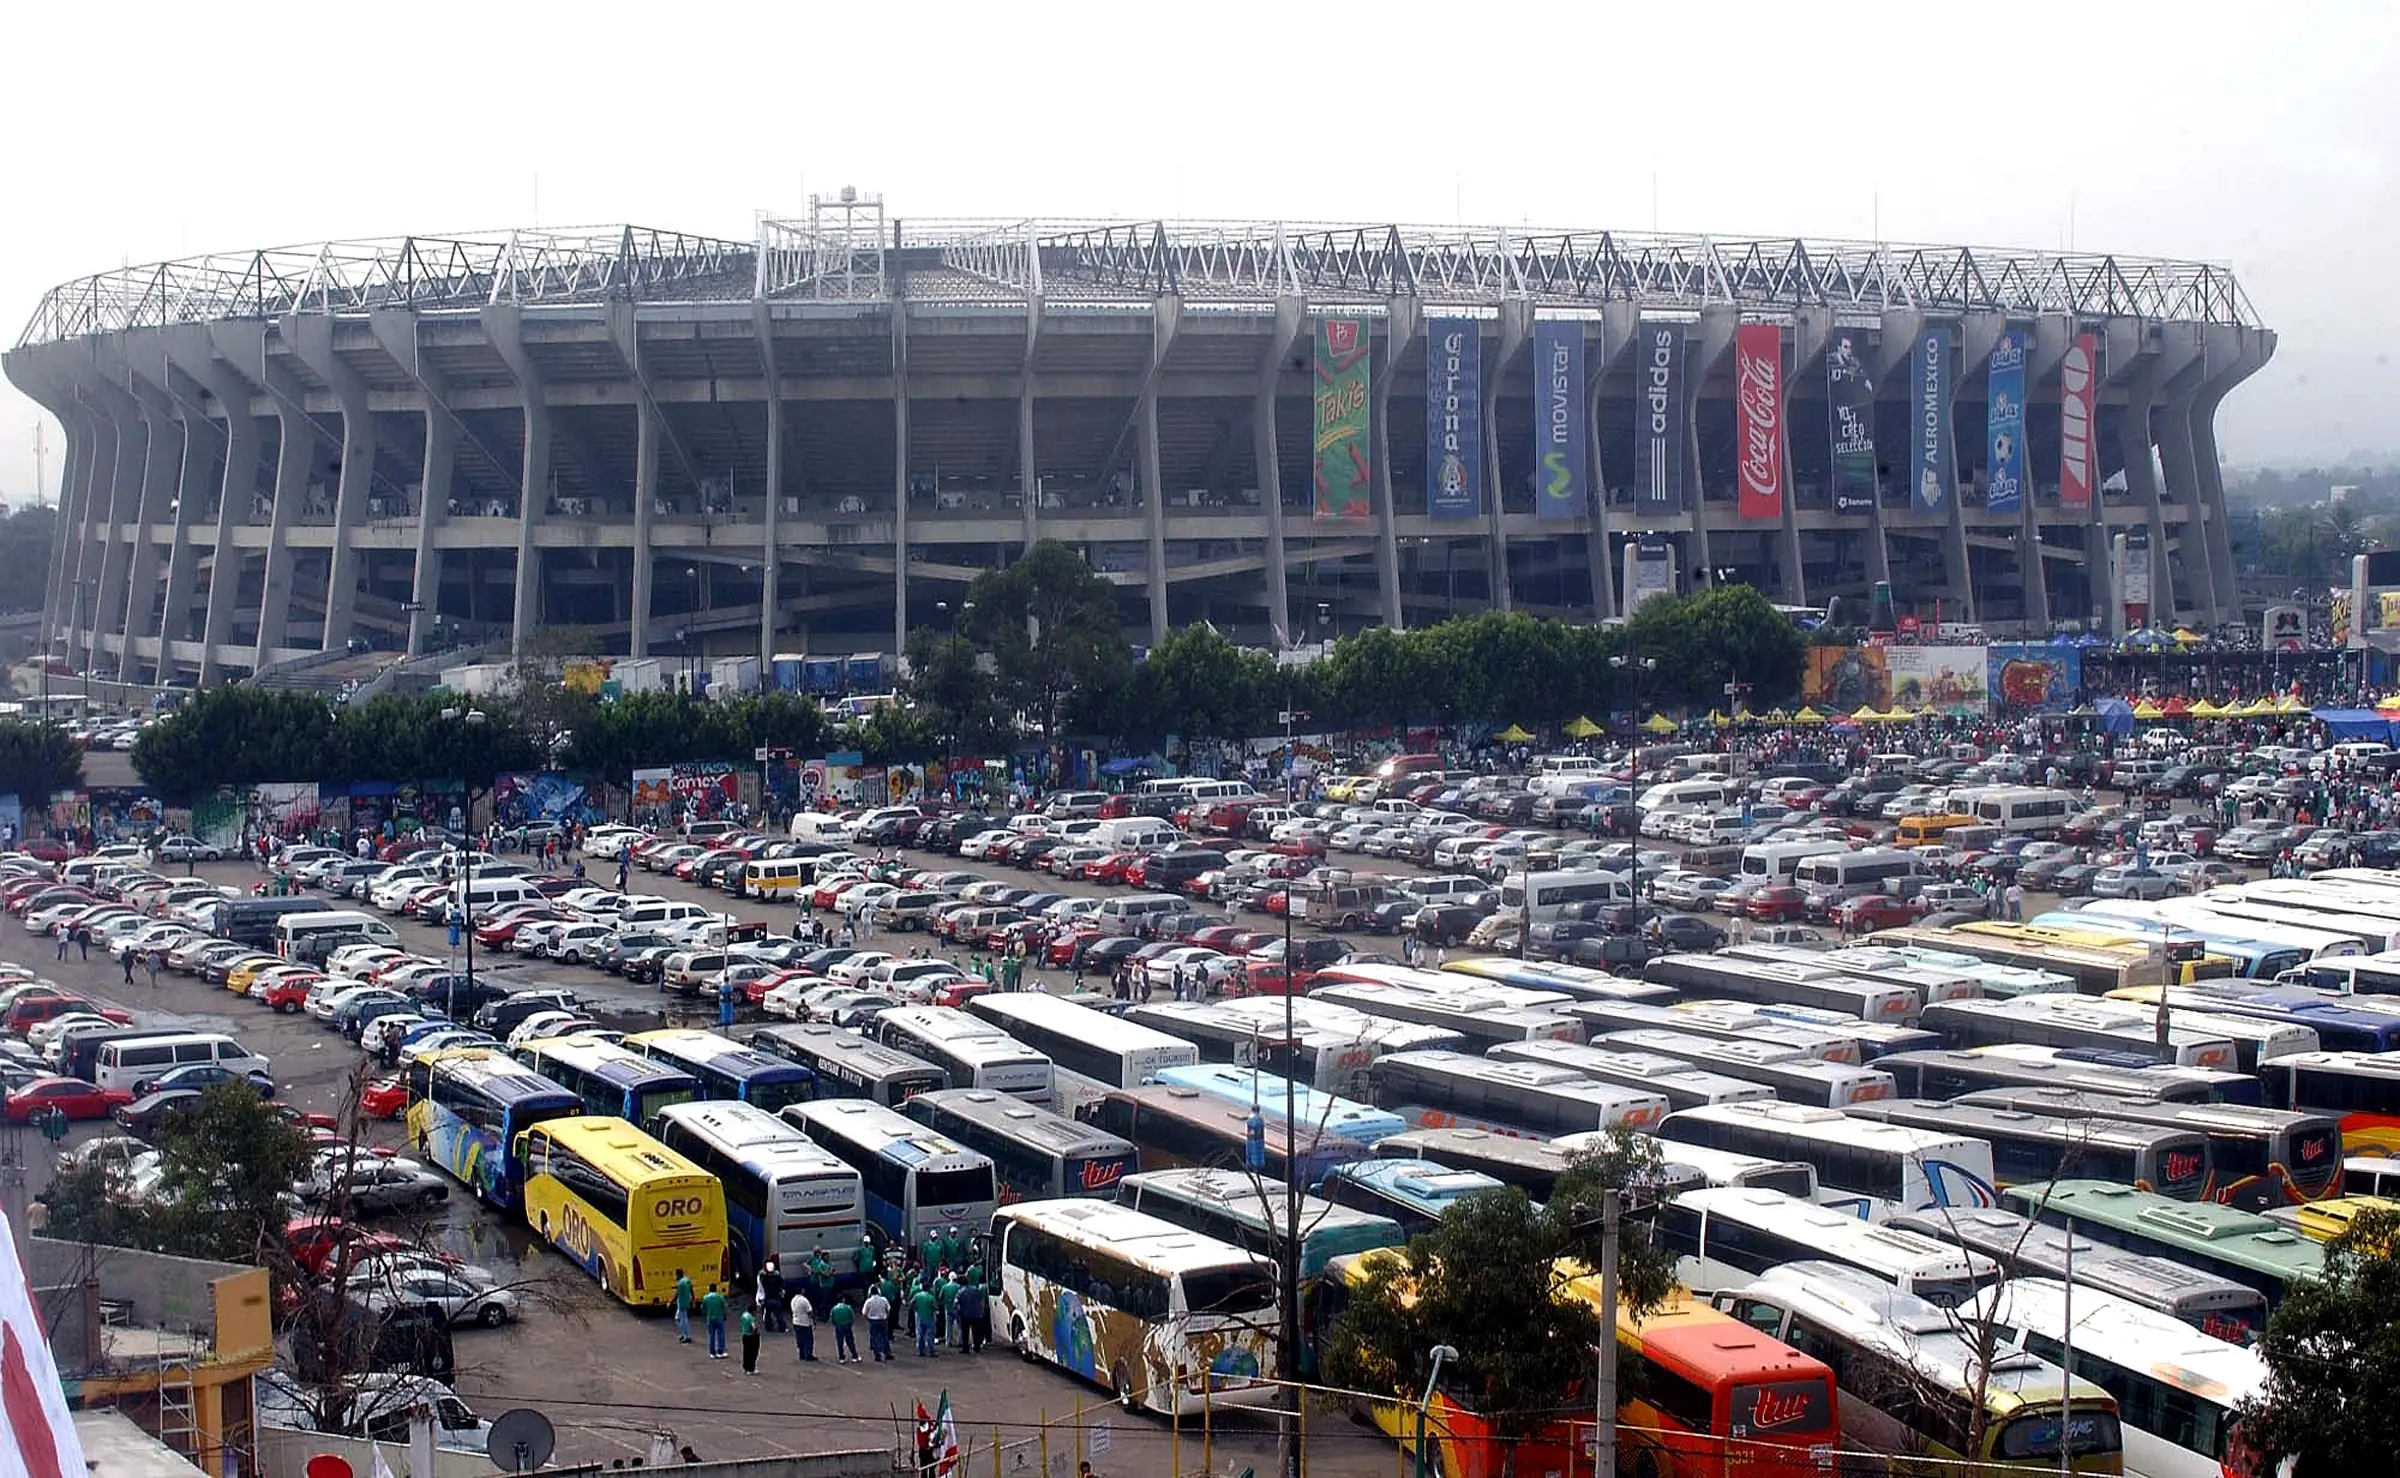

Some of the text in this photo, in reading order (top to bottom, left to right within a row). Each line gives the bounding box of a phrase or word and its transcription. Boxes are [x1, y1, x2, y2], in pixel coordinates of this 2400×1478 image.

[1317, 380, 1365, 428] Takis
[1444, 332, 1464, 452] Corona
[1552, 340, 1569, 444] movistar
[1649, 329, 1672, 434] adidas
[1924, 338, 1939, 464] AEROMEXICO
[672, 774, 728, 790] Comex
[754, 929, 761, 940] C
[562, 1202, 591, 1260] ORO
[654, 1196, 703, 1218] ORO
